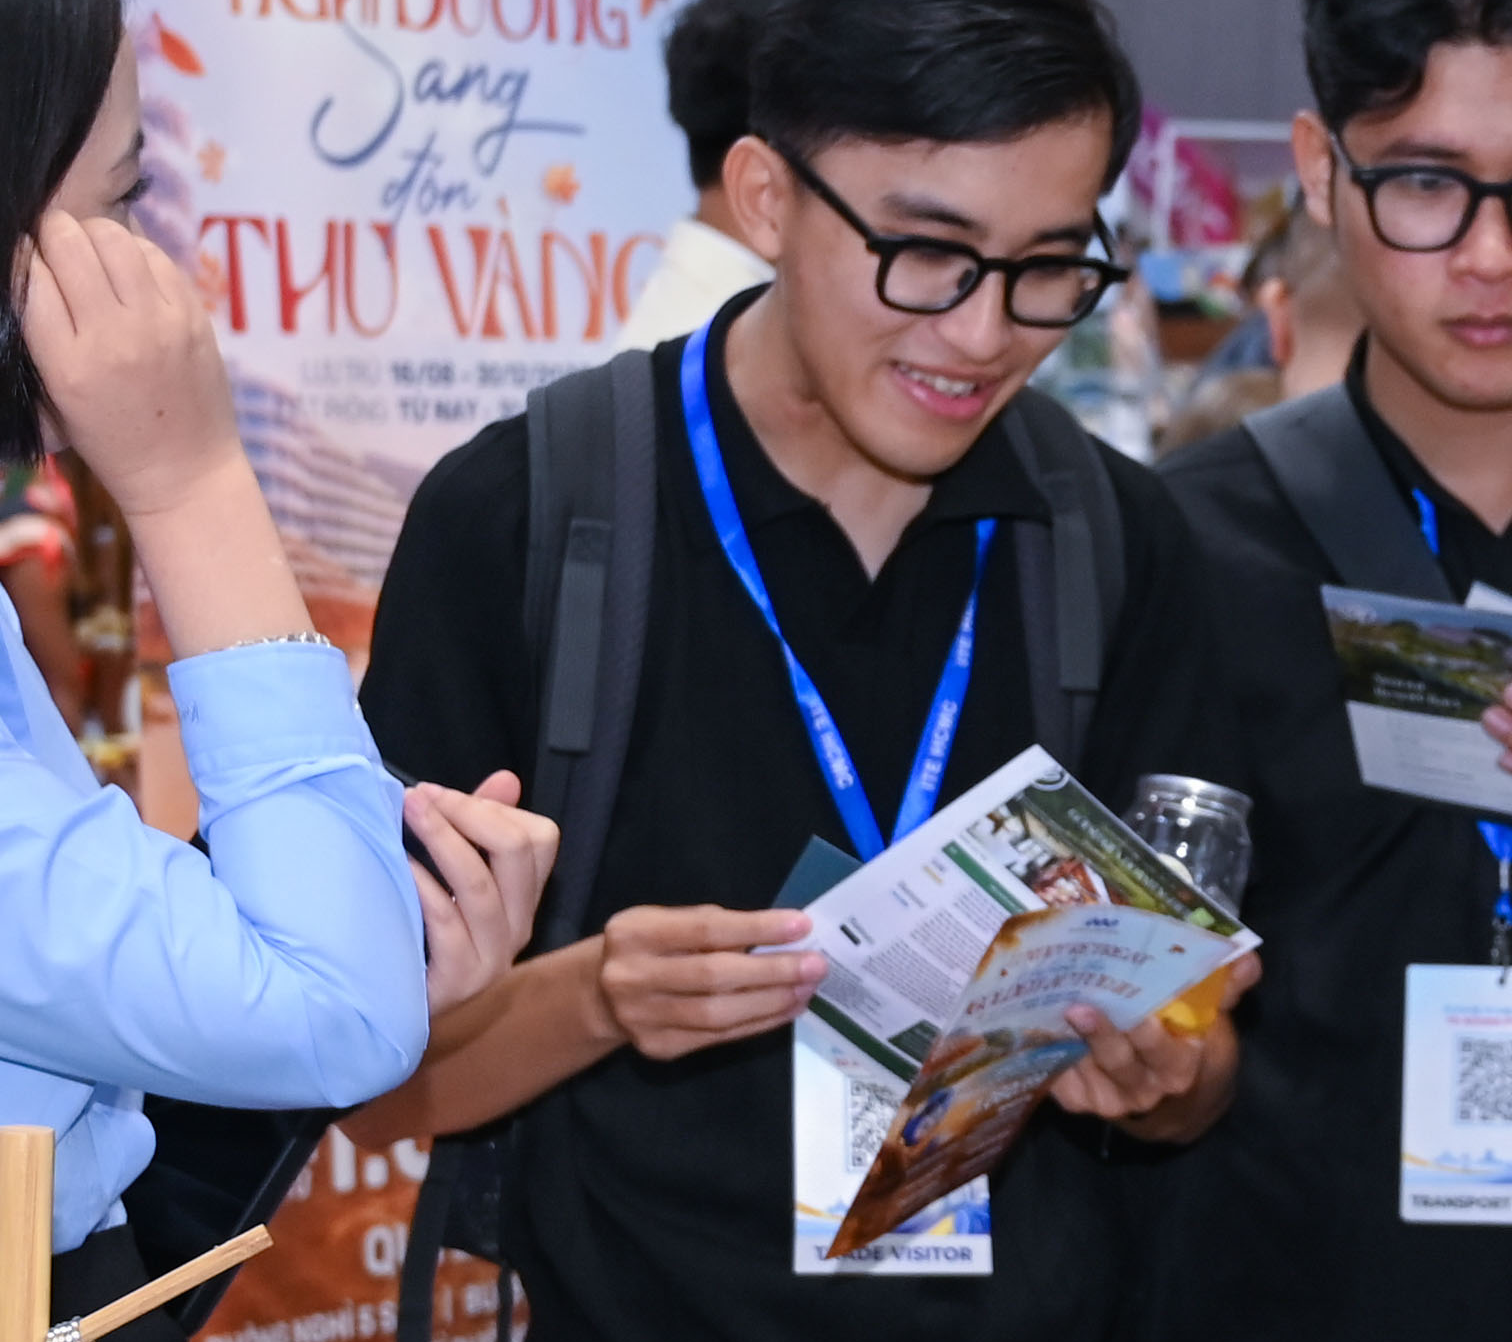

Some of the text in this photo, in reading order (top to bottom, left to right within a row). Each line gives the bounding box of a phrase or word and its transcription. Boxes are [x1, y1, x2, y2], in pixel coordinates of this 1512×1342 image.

[819, 731, 855, 791] HCMC
[920, 698, 959, 792] ITE HCMC
[1412, 1194, 1511, 1209] TRANSPORT
[815, 1245, 973, 1261] TDE VISITOR
